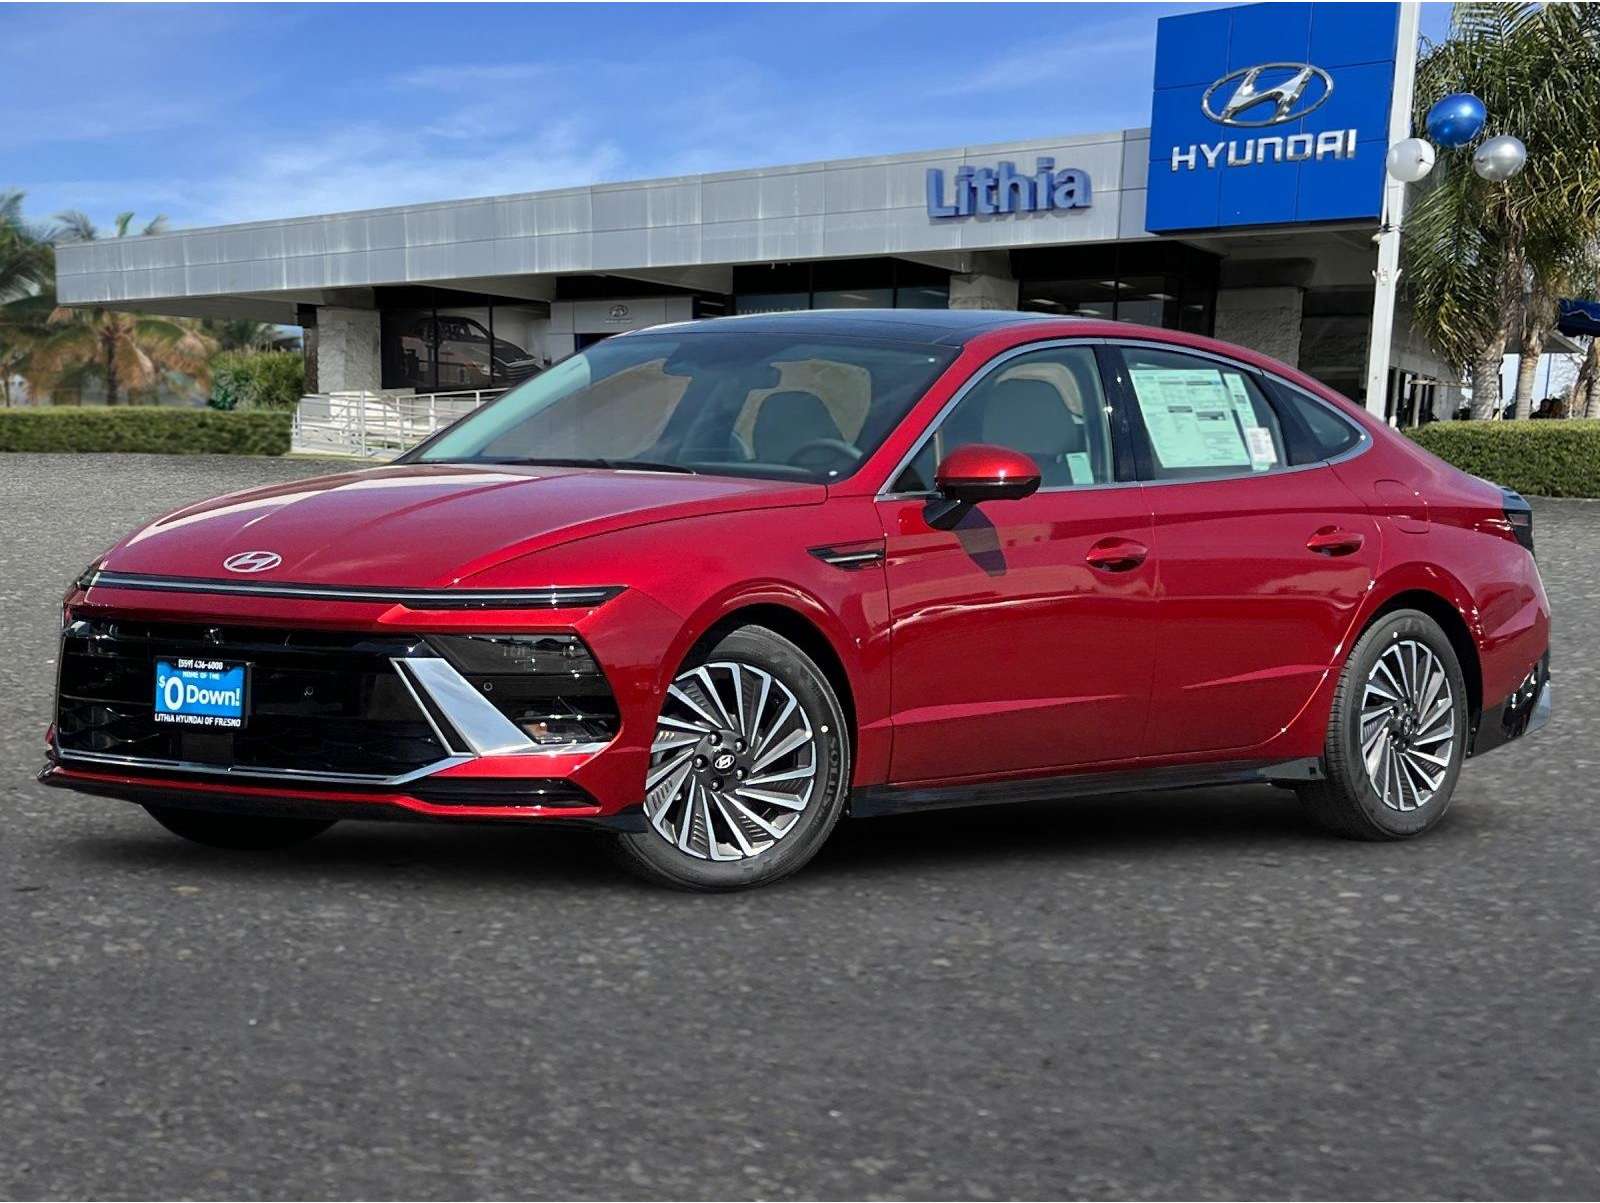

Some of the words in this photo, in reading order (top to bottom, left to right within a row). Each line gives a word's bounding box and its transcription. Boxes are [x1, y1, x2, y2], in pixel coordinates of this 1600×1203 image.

[1171, 129, 1357, 171] HYUNDAI
[926, 157, 1092, 218] Lithia
[194, 660, 223, 670] 436-6000
[186, 684, 240, 706] Down!
[154, 713, 175, 722] LITHIA
[175, 714, 204, 724] HYUNDAI
[204, 716, 214, 725] OF
[214, 717, 241, 727] FRESNO
[822, 736, 839, 808] SOLUS
